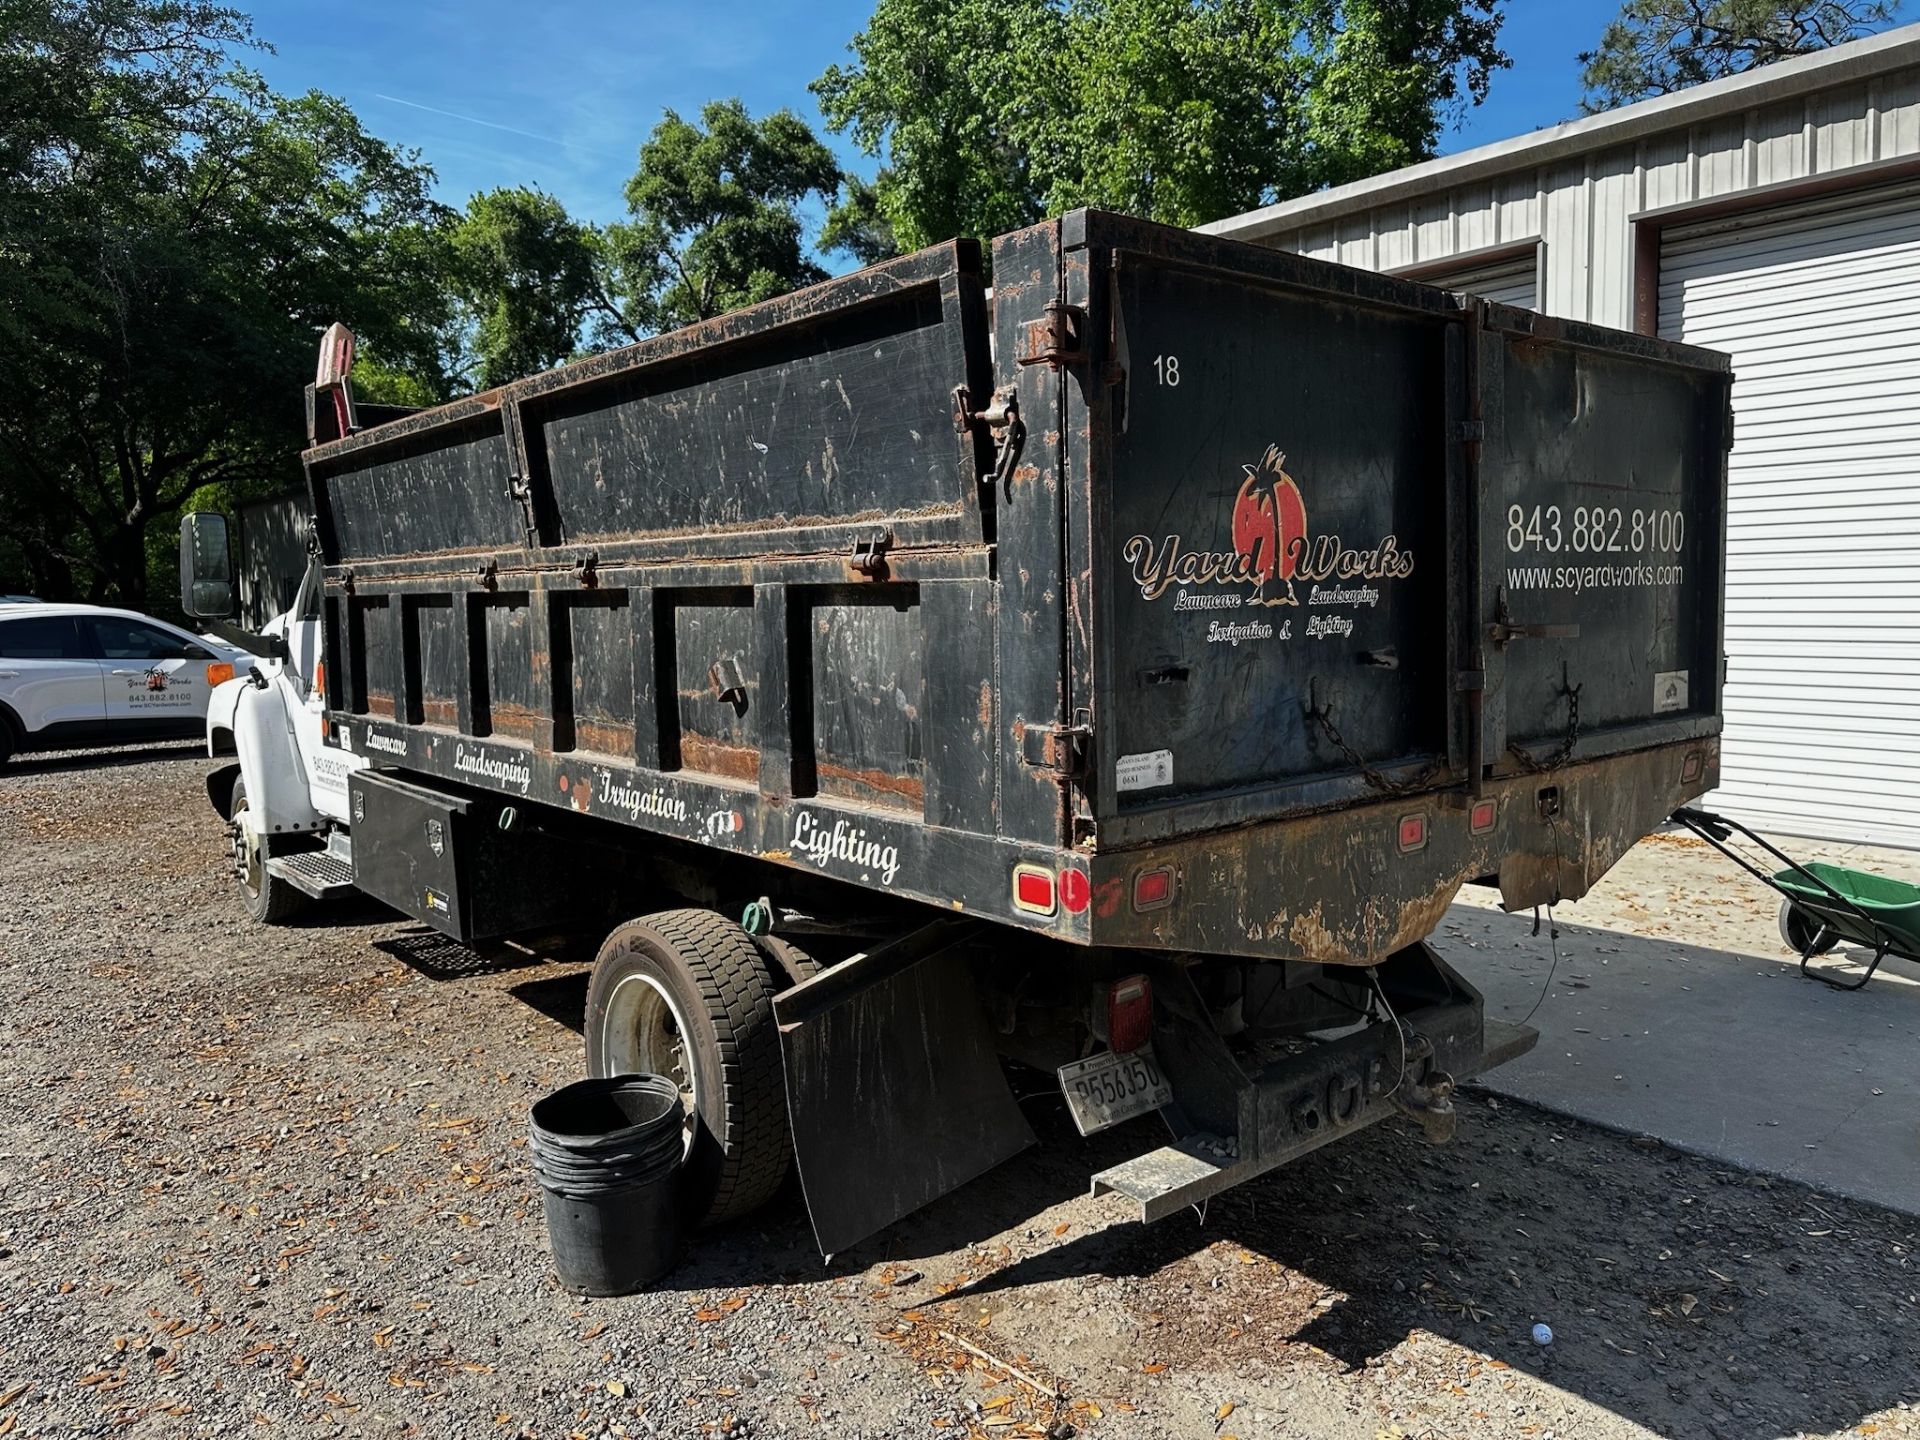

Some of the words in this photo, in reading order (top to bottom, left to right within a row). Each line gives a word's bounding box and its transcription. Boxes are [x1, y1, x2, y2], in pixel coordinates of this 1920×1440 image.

[1153, 354, 1181, 388] 18
[1506, 503, 1685, 553] 843.882.8100
[1123, 533, 1265, 601] Yard
[1287, 534, 1415, 580] Works
[1506, 559, 1684, 596] www.scyardworks.com
[1173, 589, 1242, 611] Lawncare
[1308, 583, 1380, 608] Landscaping
[1207, 620, 1273, 646] Irrigation
[1279, 619, 1292, 640] &
[1305, 614, 1354, 640] Lighting
[127, 678, 147, 688] Yard
[169, 678, 192, 686] Works
[128, 693, 192, 703] 843.882.8100
[365, 724, 408, 757] Lawncare
[453, 742, 532, 793] Landscaping
[598, 773, 688, 823] Irrigation
[789, 811, 901, 886] Lighting
